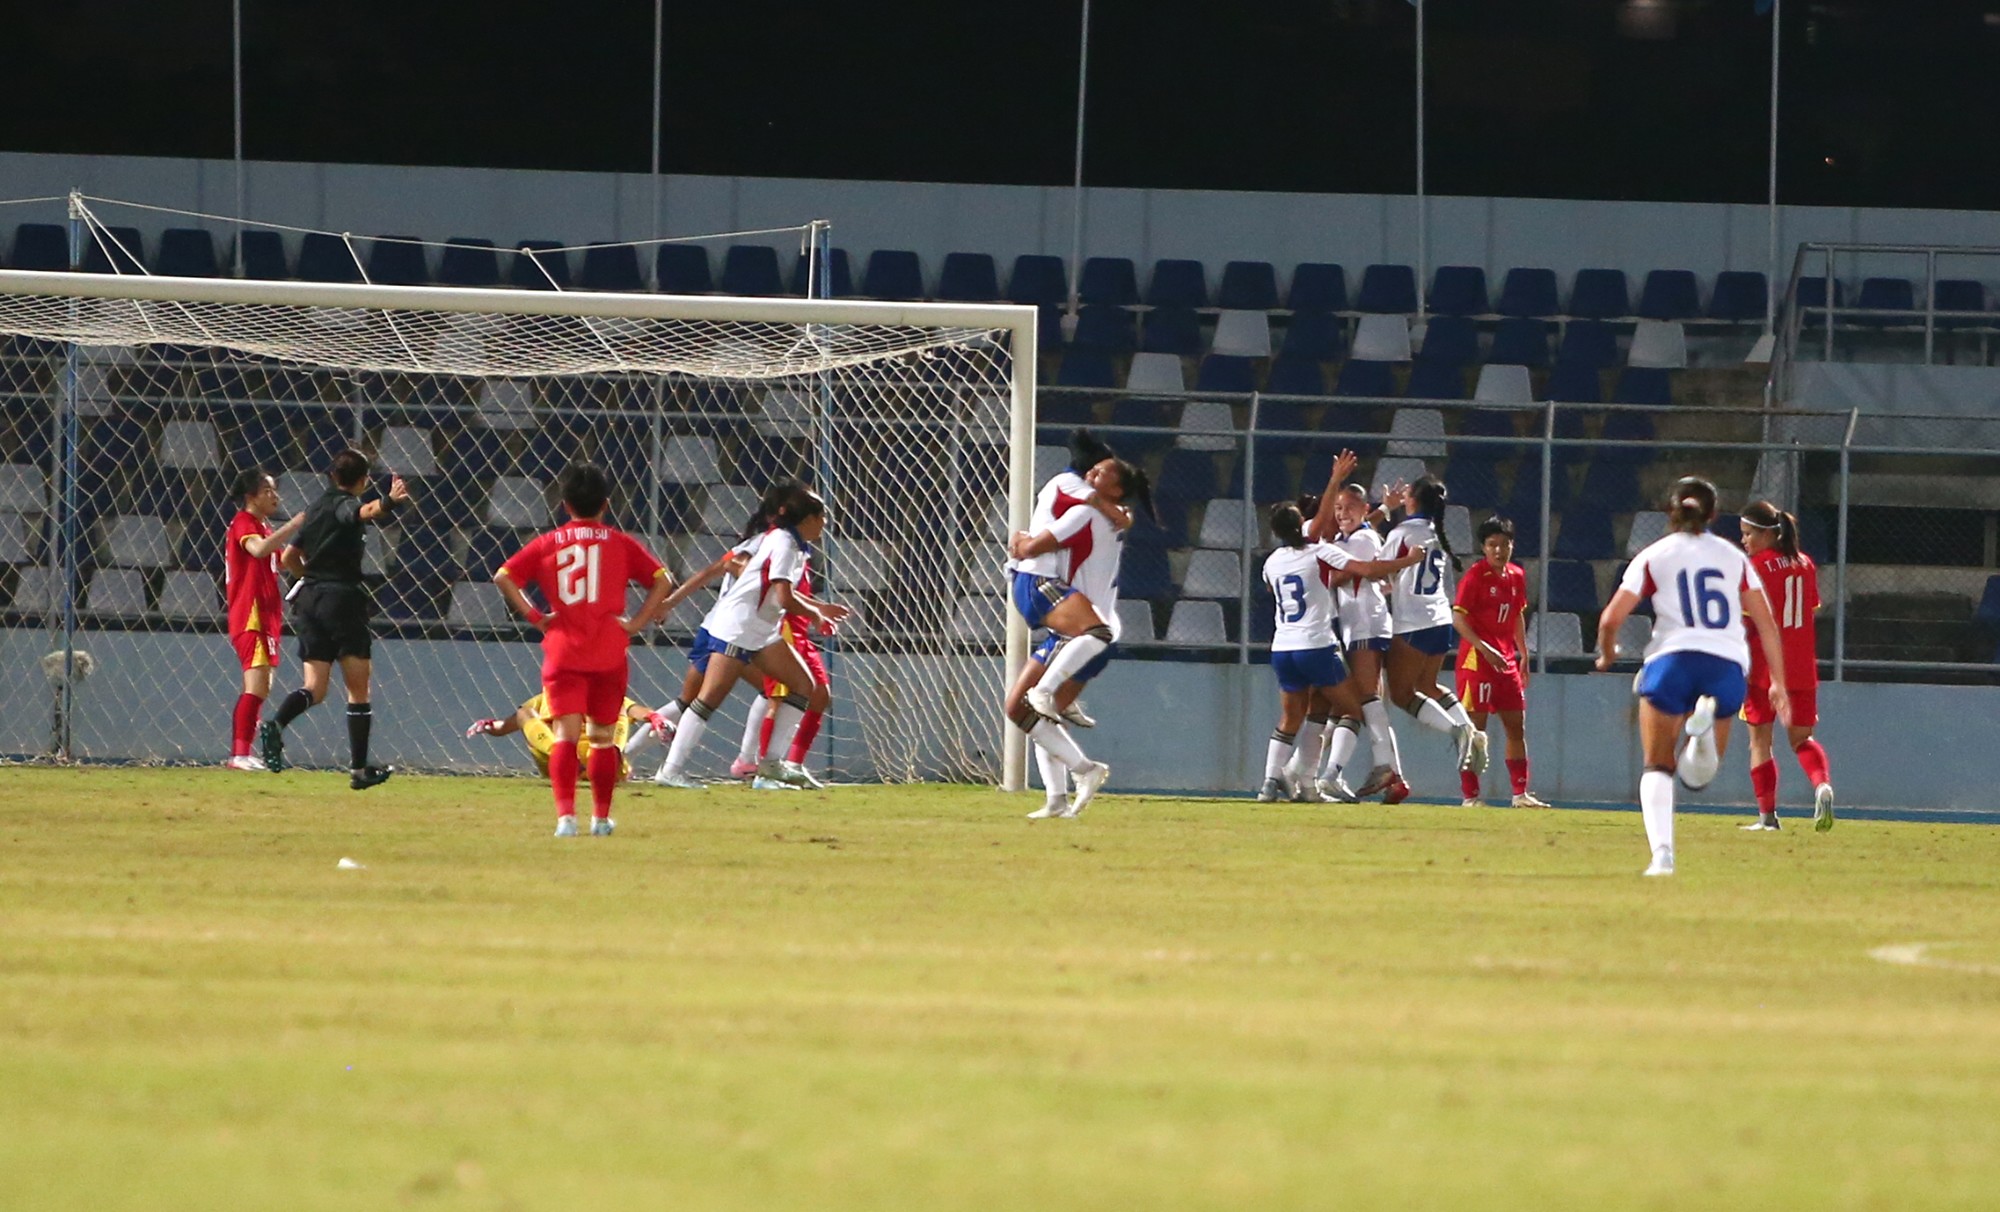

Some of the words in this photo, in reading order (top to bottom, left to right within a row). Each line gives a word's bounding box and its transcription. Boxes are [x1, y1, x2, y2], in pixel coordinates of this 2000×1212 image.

[556, 543, 600, 606] 21
[1414, 547, 1444, 596] 15
[1274, 574, 1307, 623] 13
[1497, 603, 1510, 624] 17
[1677, 566, 1731, 630] 16
[1782, 574, 1804, 630] 11
[1479, 682, 1492, 704] 17
